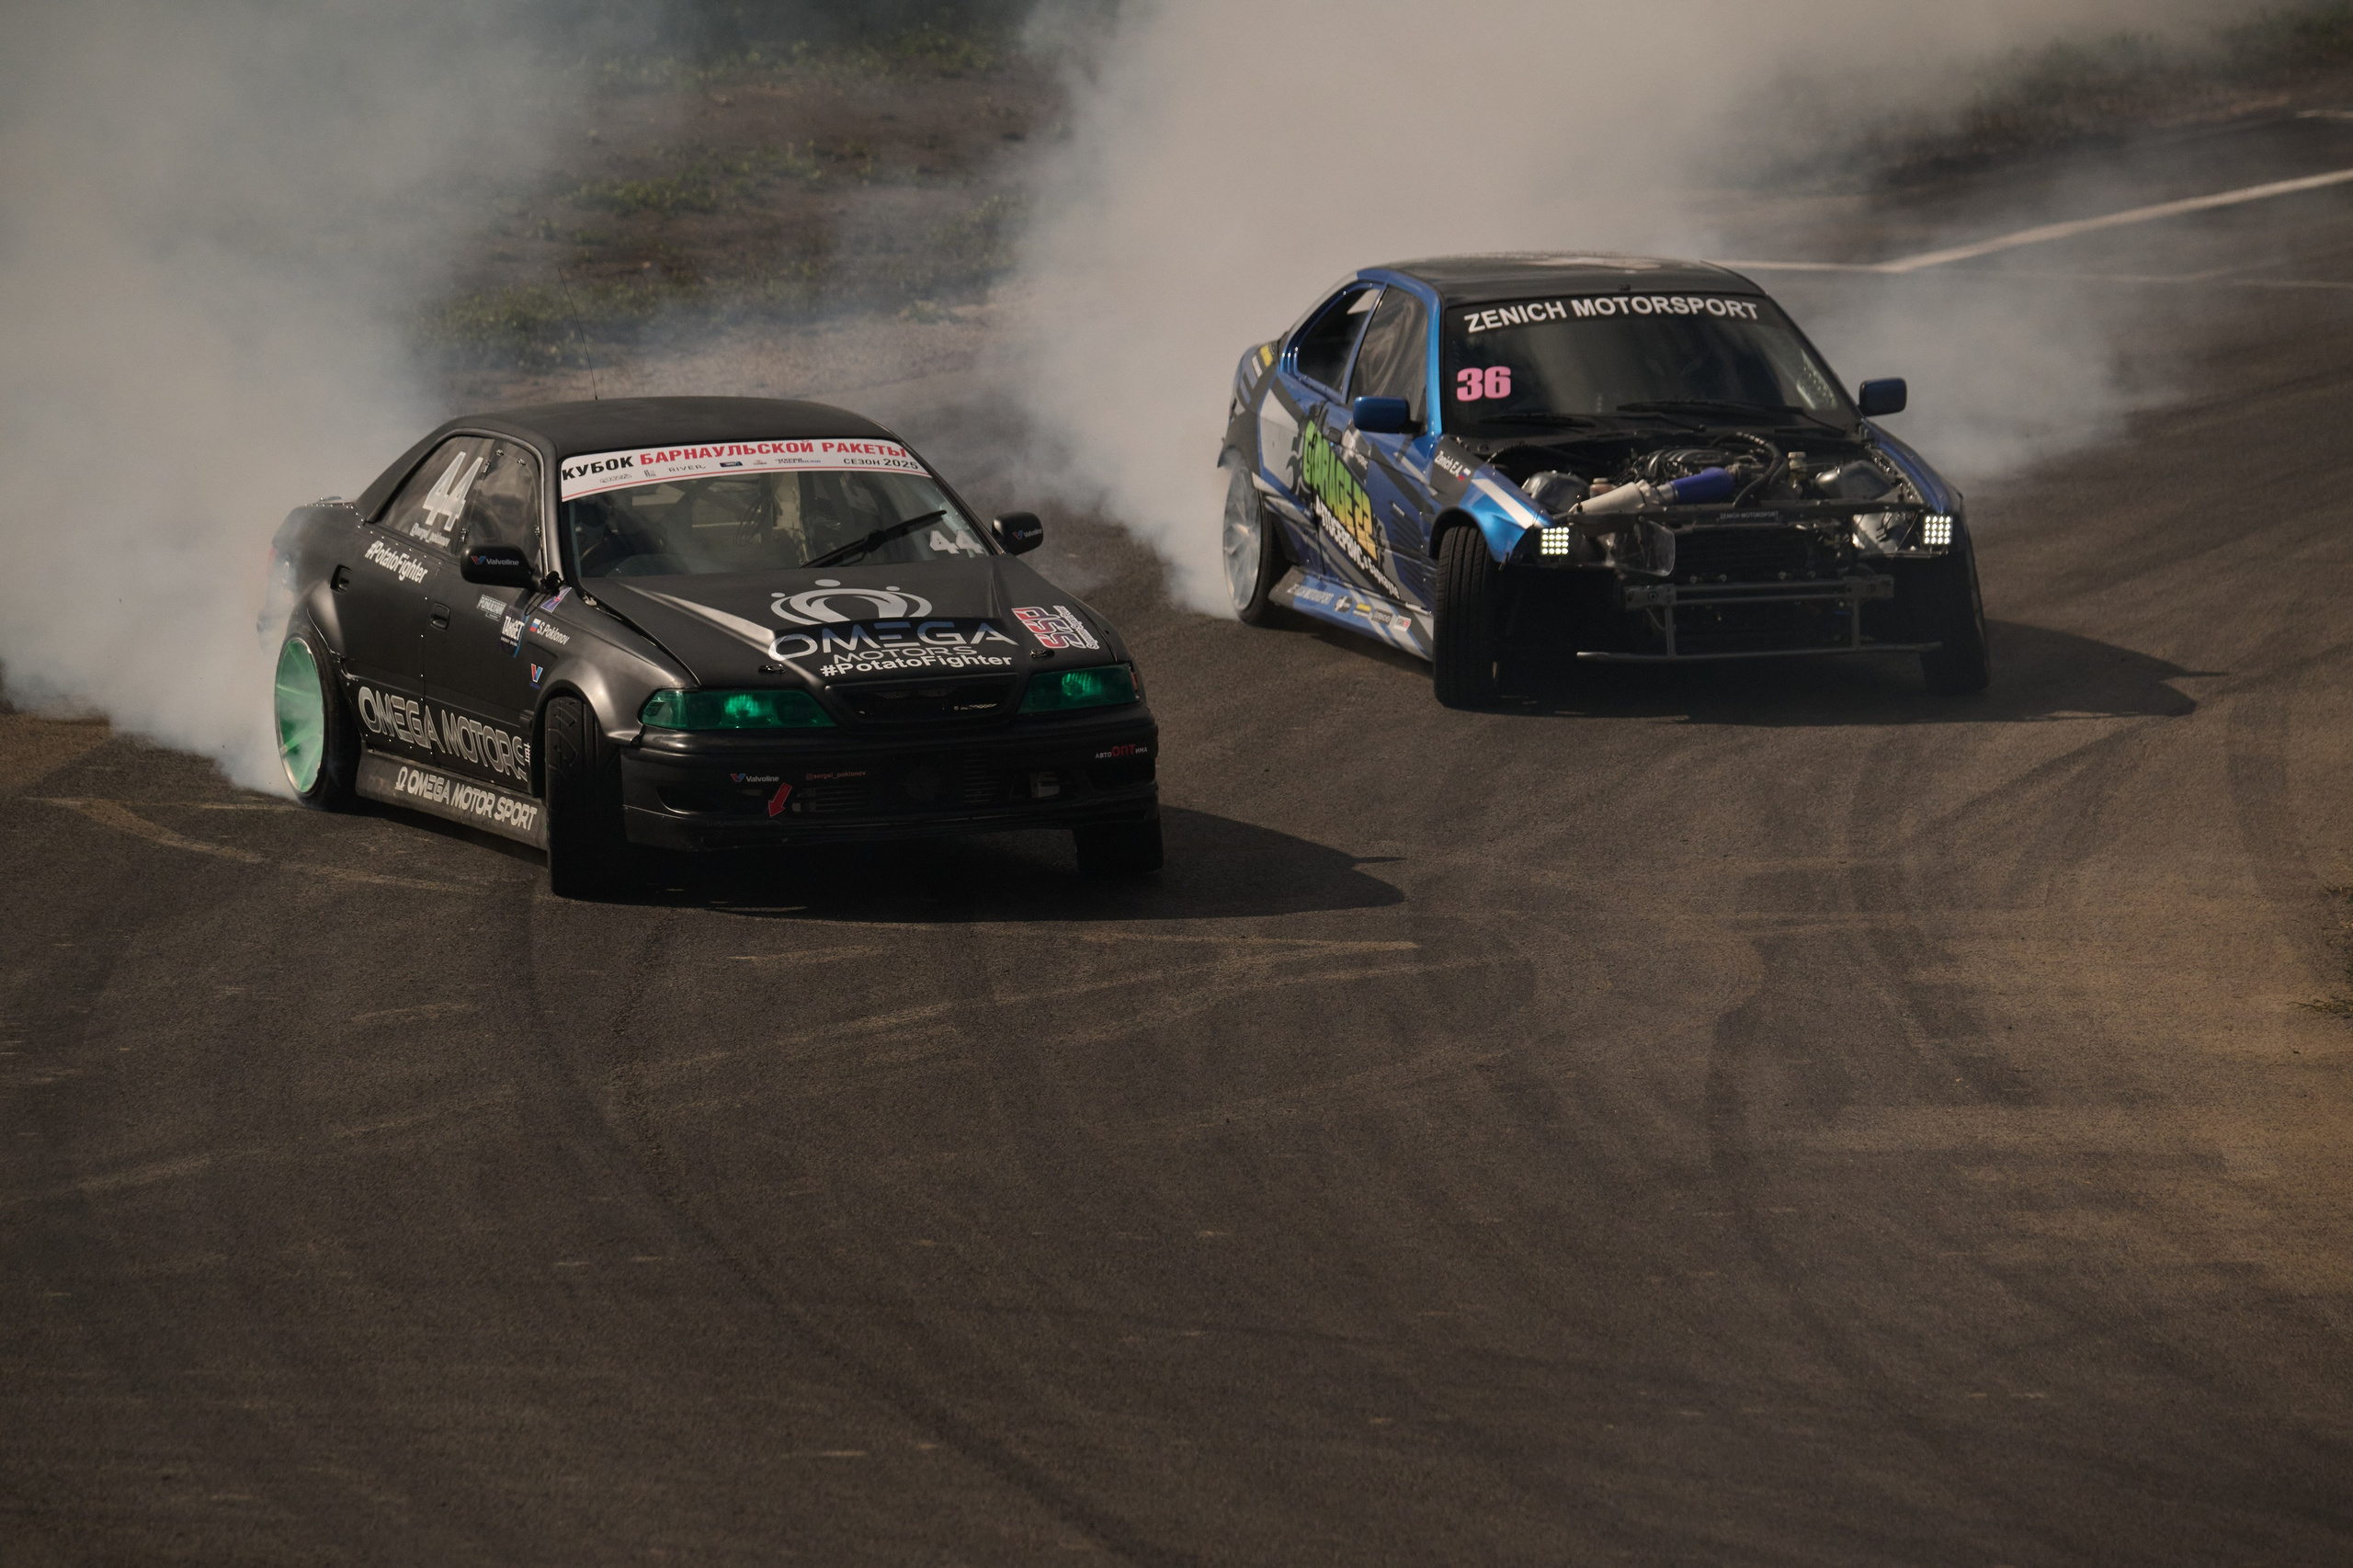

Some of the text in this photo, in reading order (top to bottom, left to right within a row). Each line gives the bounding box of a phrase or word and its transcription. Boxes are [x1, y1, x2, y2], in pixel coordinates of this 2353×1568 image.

[1464, 296, 1758, 333] ZENICH MOTORSPORT
[1457, 366, 1511, 402] 36
[563, 456, 634, 481] КУБОК
[640, 439, 814, 465] БАРНАУЛЬСКОЙ
[822, 442, 907, 458] РАКЕТЫ
[843, 459, 919, 471] СЕЗОН 2025
[423, 451, 483, 532] 44
[929, 529, 984, 555] 44
[365, 540, 428, 584] #PotatoFighter
[486, 558, 519, 566] Valvoline
[768, 620, 1020, 662] OMEGA
[833, 646, 977, 665] MOTORS
[820, 655, 1012, 677] #PotatoFighter
[358, 686, 529, 782] OMEGA MOTORS
[407, 769, 538, 831] OMEGA MOTOR SPORT
